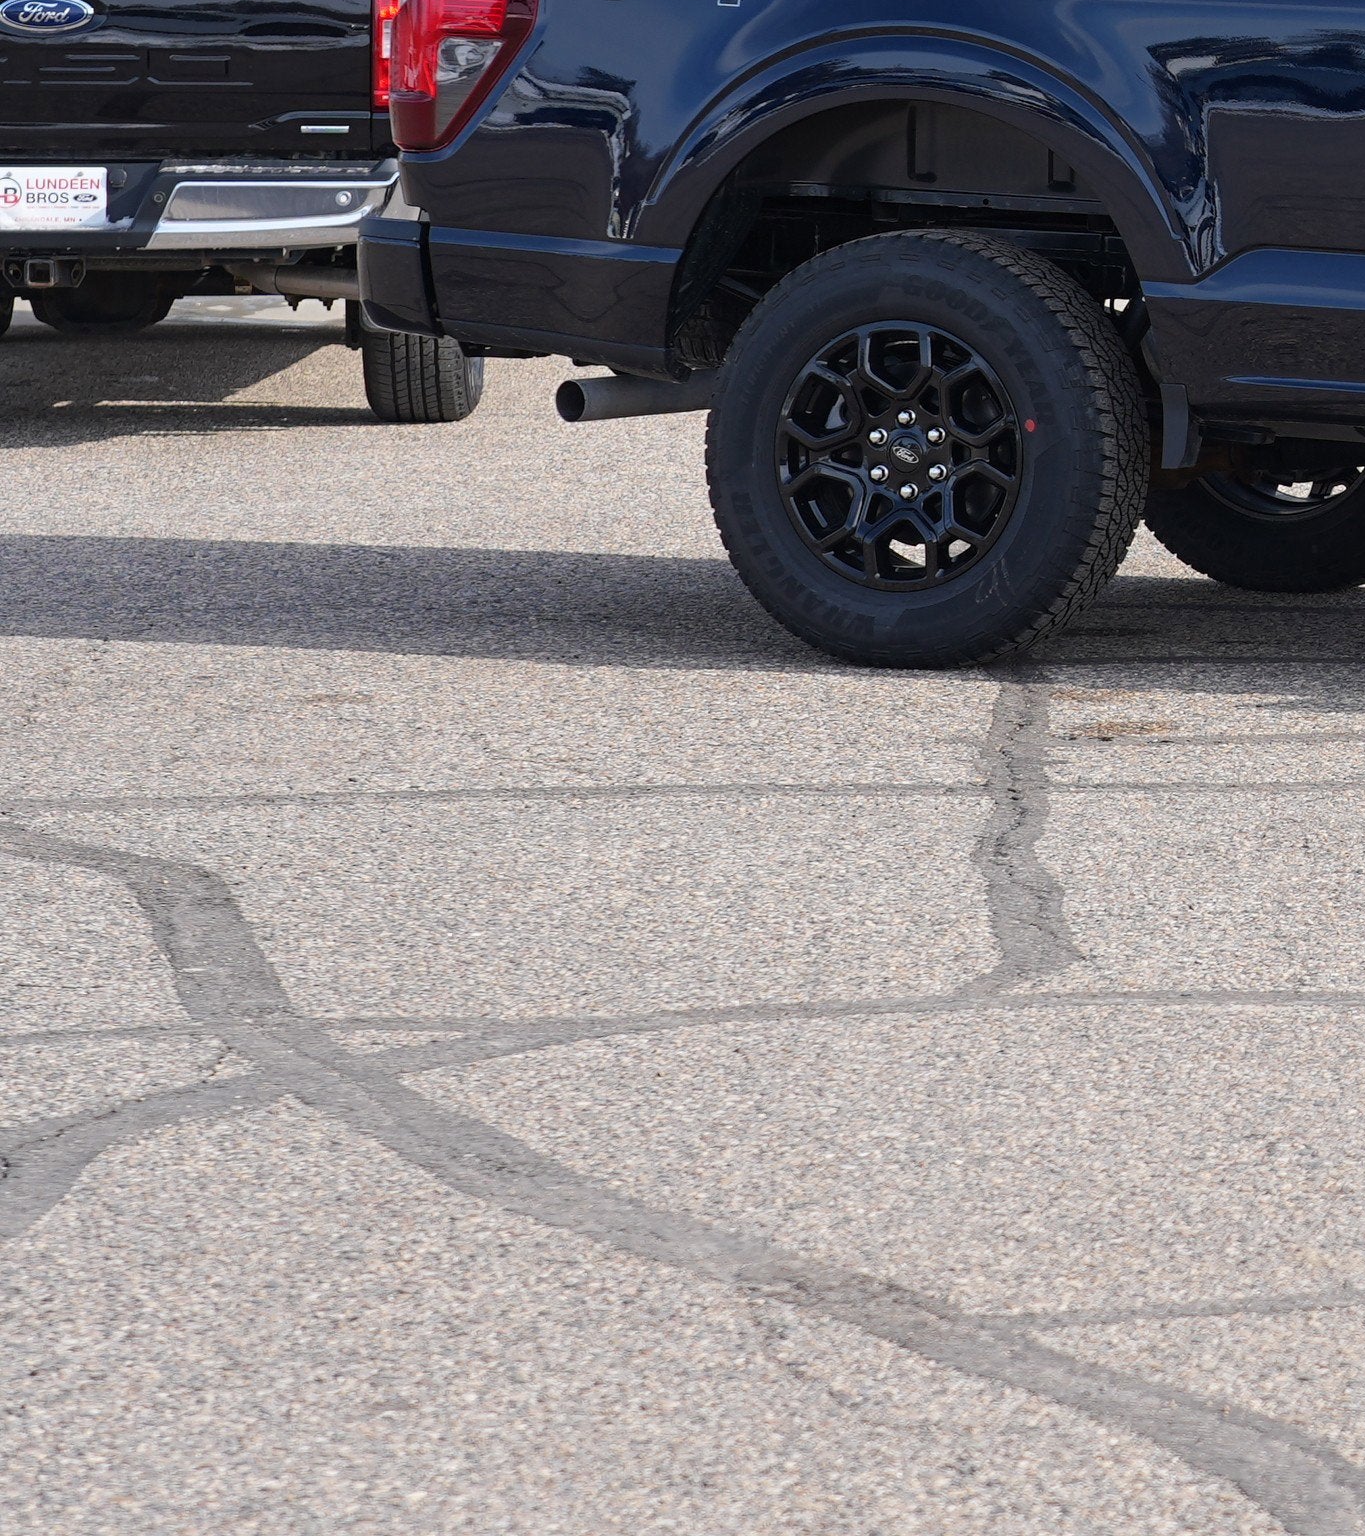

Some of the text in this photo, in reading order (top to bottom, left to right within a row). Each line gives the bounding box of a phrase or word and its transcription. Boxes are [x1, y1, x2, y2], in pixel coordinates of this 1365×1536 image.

[18, 1, 72, 24] Ford
[26, 178, 100, 190] LUNDEEN
[26, 192, 69, 204] BROS
[895, 447, 916, 463] Ford
